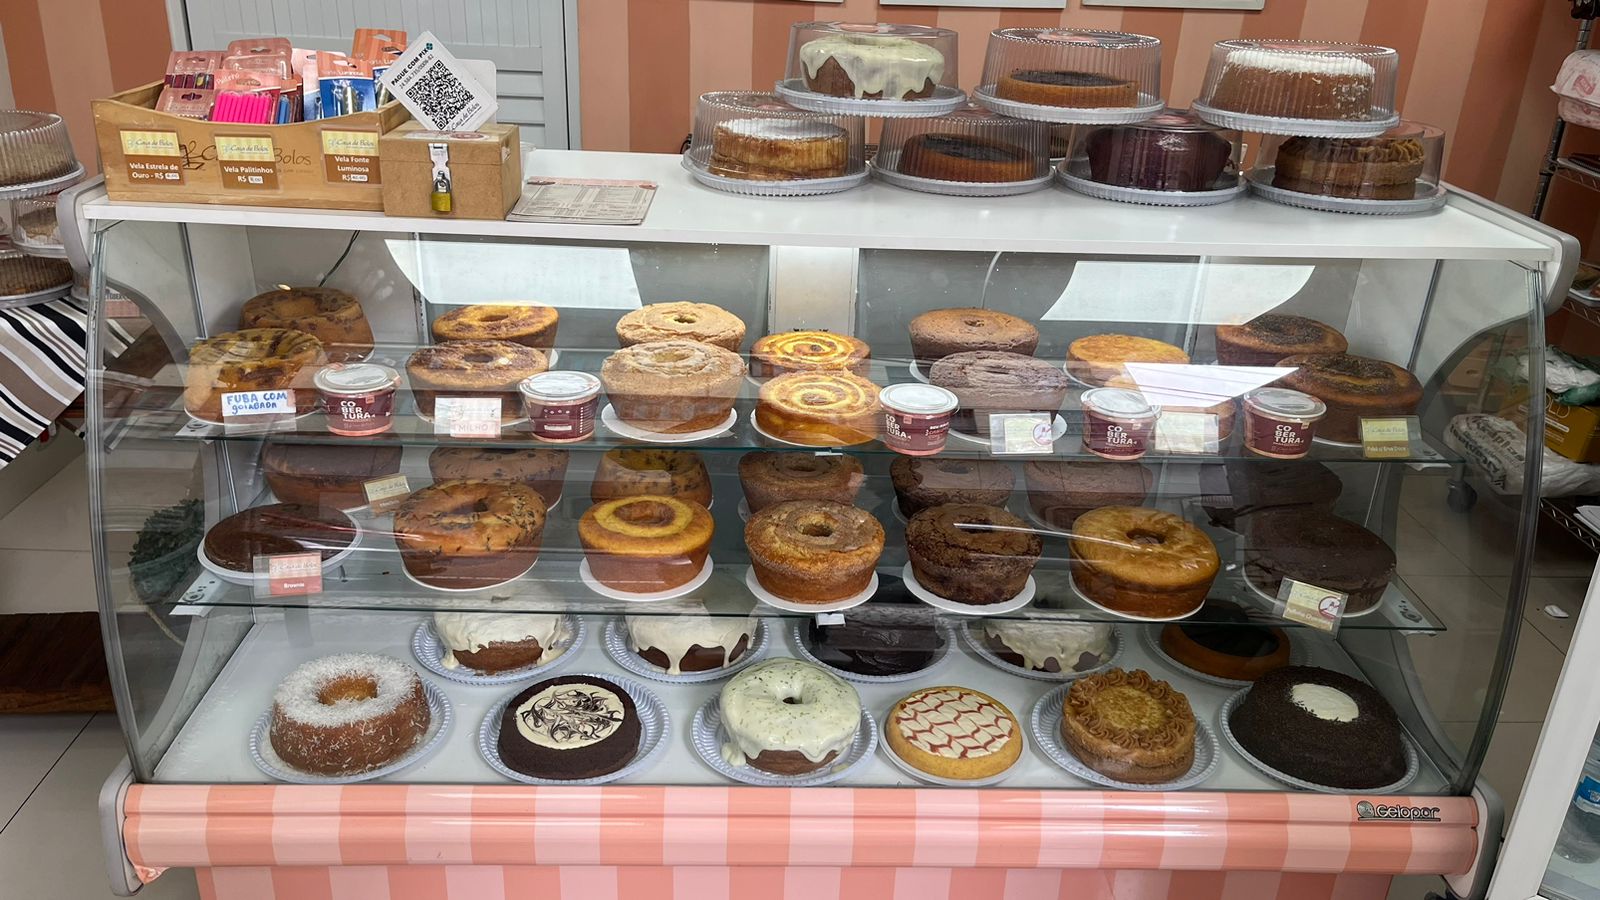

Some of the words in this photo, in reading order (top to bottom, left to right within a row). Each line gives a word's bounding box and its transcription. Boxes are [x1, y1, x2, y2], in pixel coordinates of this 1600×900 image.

[391, 68, 409, 86] PAGUE
[407, 56, 421, 70] COM
[418, 48, 429, 59] PIX
[334, 155, 350, 163] Vela
[129, 162, 145, 170] Vela
[145, 163, 169, 171] Estrela
[169, 163, 179, 171] de
[240, 166, 274, 174] Palitinhos
[337, 165, 370, 173] Luminosa
[132, 171, 150, 179] Ouro
[154, 172, 164, 180] R$
[237, 175, 247, 183] R$
[342, 174, 351, 182] R$
[226, 393, 259, 406] FUBA
[263, 392, 288, 401] COM
[341, 406, 363, 414] BER
[342, 411, 371, 420] TURA
[885, 413, 896, 423] CO
[458, 423, 489, 432] MILHO
[886, 419, 901, 431] BER
[1107, 425, 1123, 433] CO
[1276, 424, 1292, 432] CO
[887, 426, 907, 439] TURA
[1107, 431, 1128, 439] BER
[1275, 430, 1296, 438] BER
[1106, 436, 1133, 445] TURA
[1274, 435, 1301, 444] TURA
[1376, 804, 1441, 820] Gelopar
